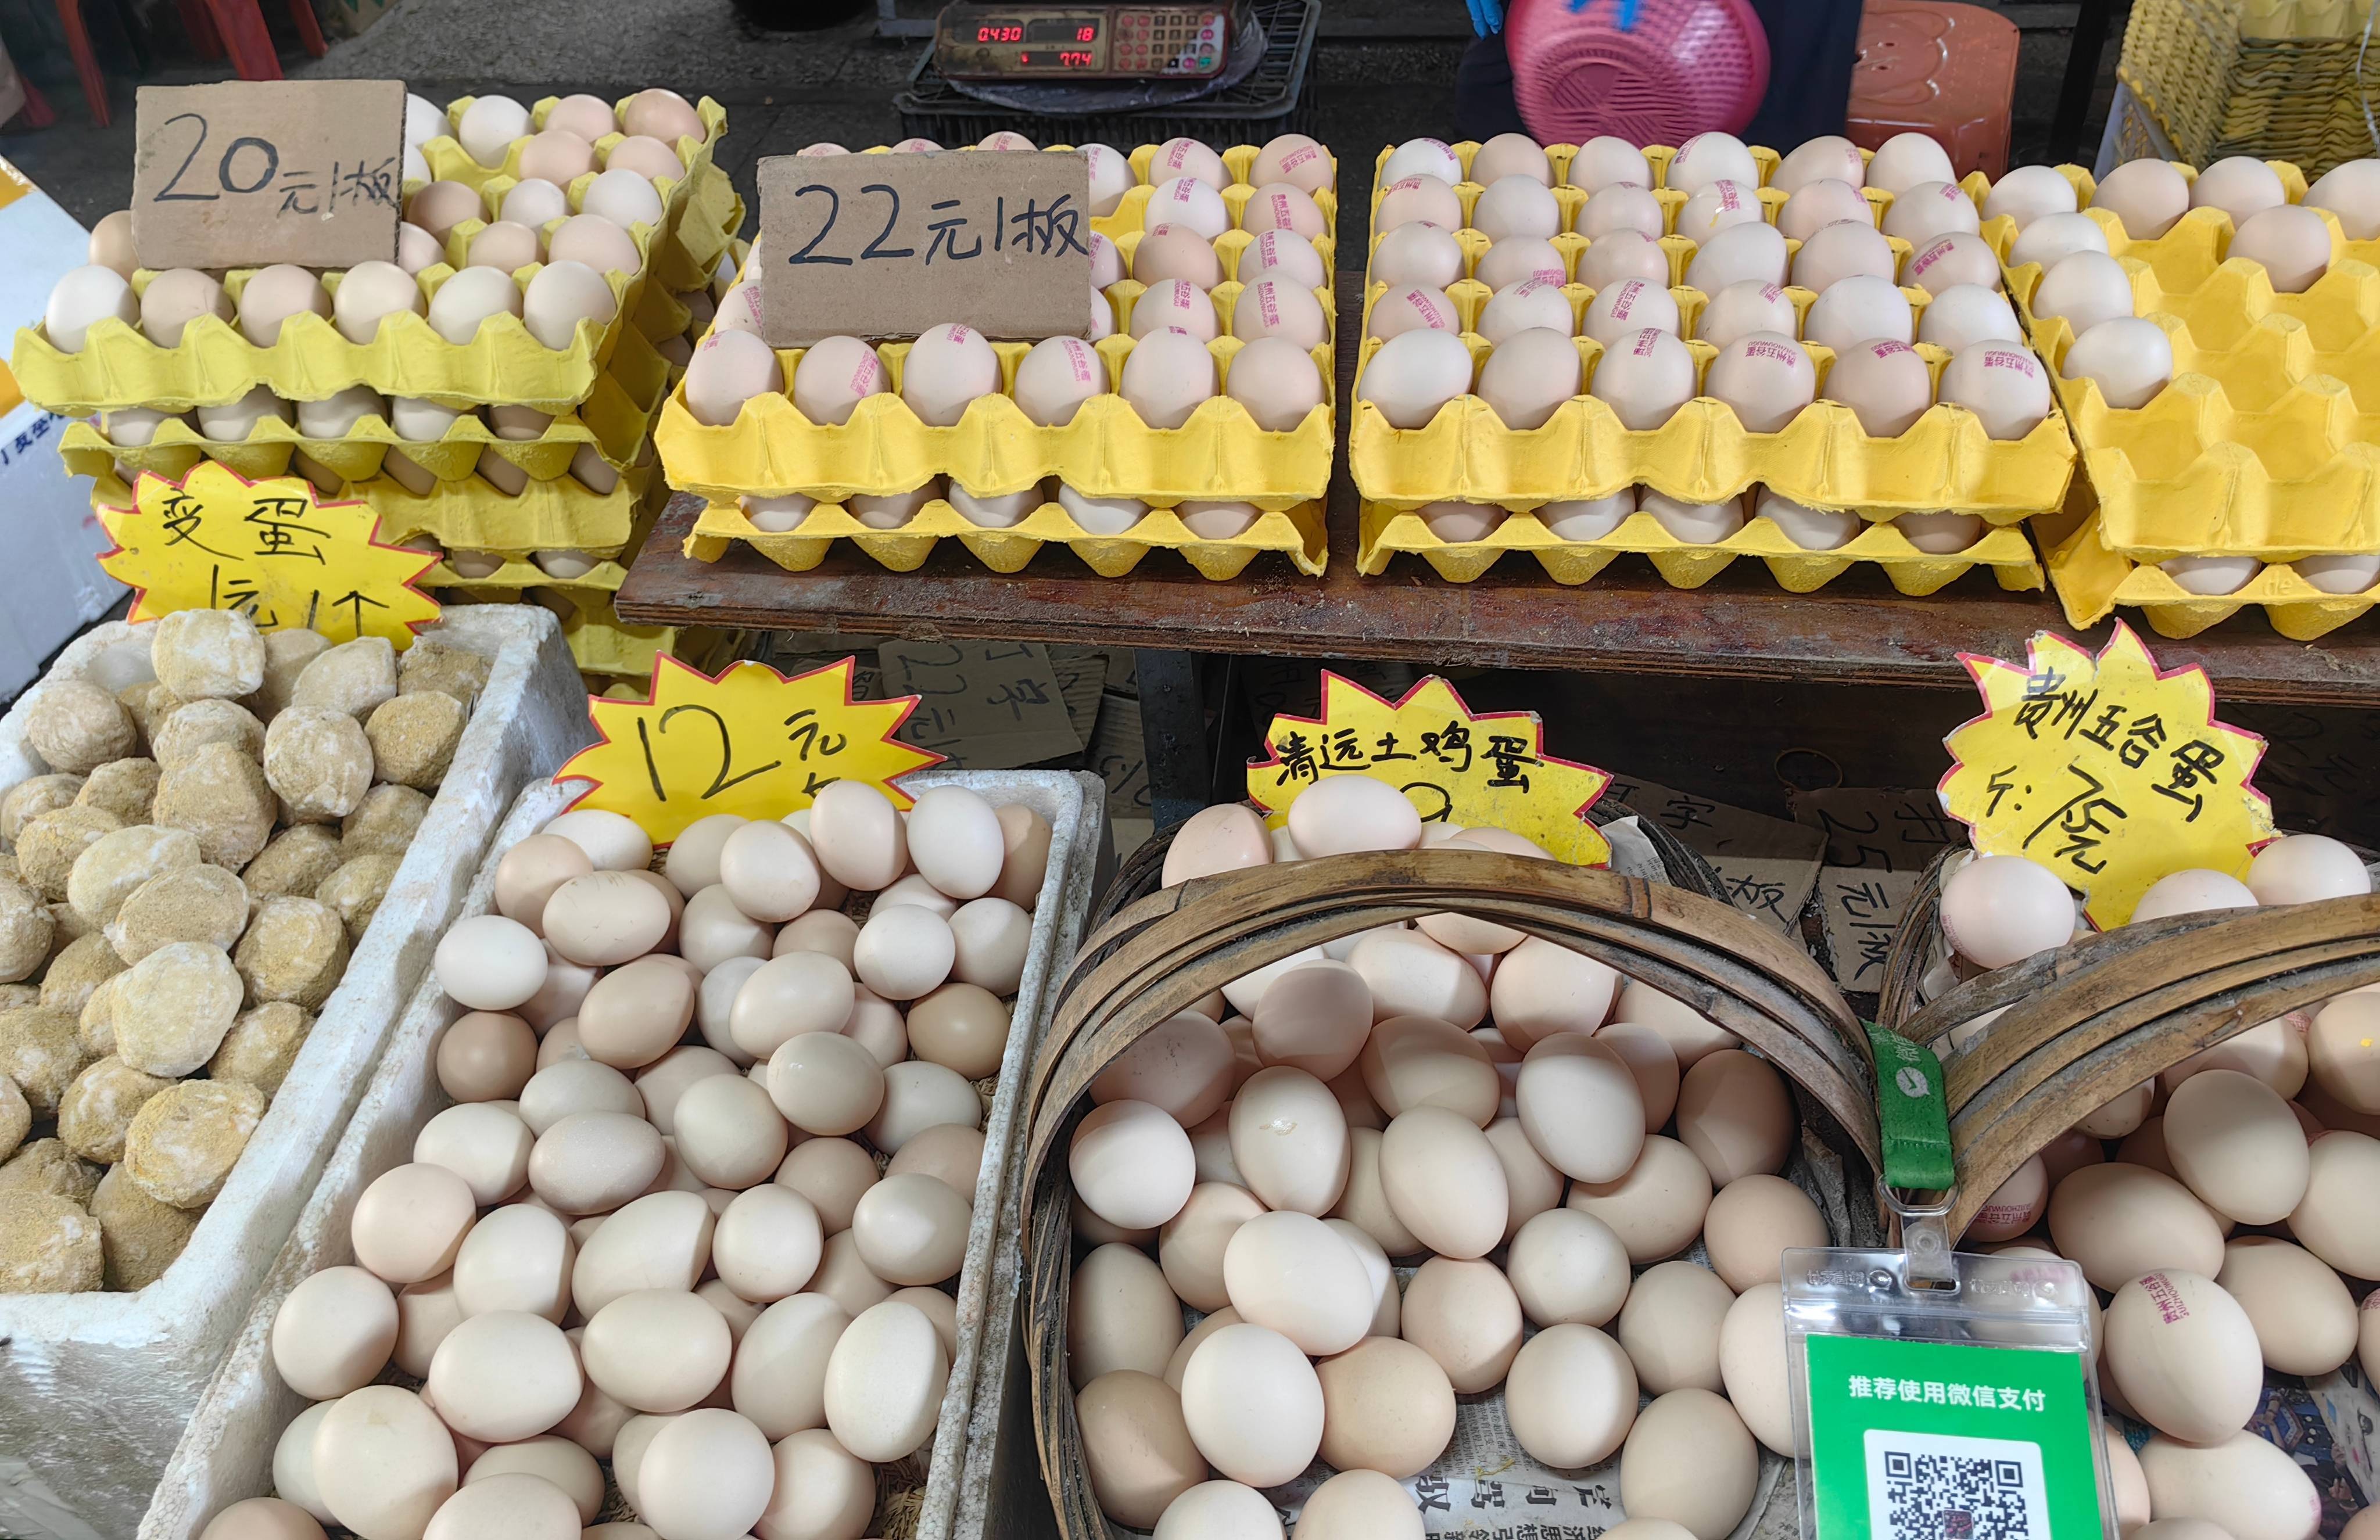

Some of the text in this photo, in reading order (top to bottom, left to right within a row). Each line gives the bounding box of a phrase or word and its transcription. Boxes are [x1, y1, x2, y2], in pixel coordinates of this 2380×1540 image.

[153, 113, 399, 218] 20元1板
[788, 184, 1089, 265] 22元1板
[1276, 720, 1544, 794] 清远土鸡蛋
[2014, 666, 2225, 823] 贵州五谷蛋
[1848, 1374, 2046, 1412] 推荐使用微信支付
